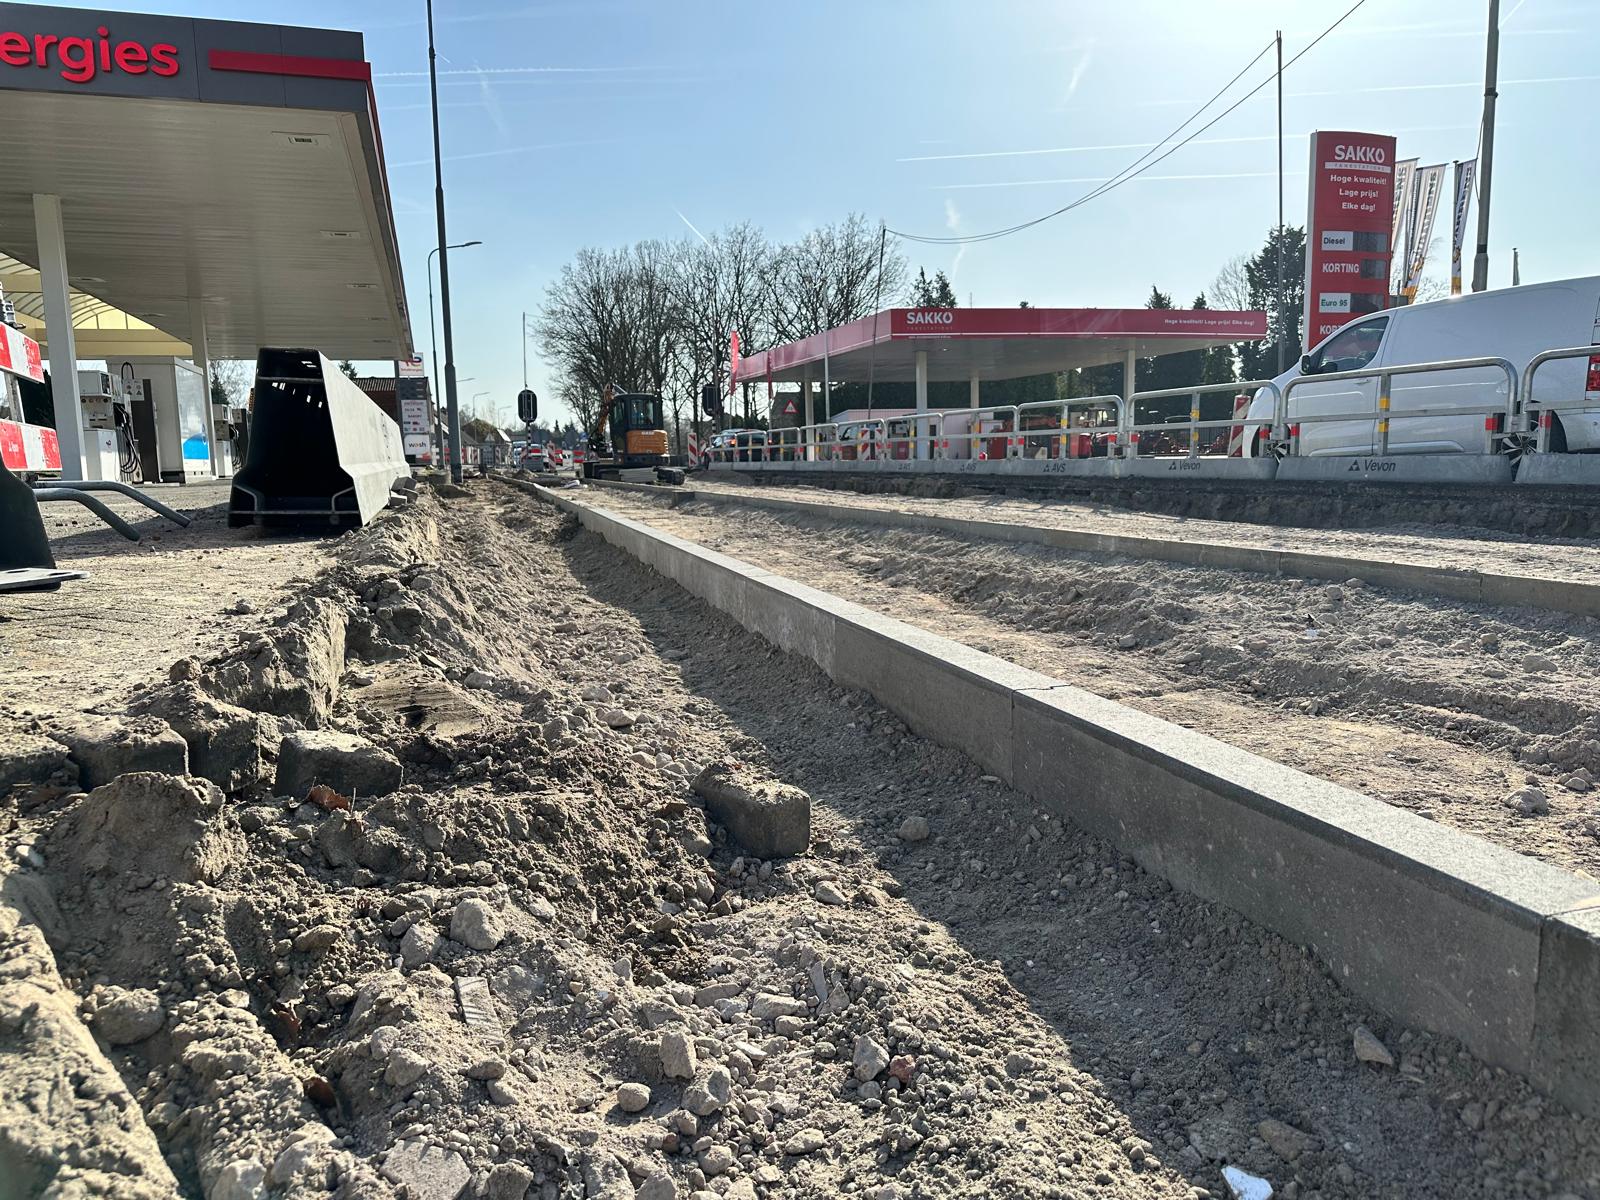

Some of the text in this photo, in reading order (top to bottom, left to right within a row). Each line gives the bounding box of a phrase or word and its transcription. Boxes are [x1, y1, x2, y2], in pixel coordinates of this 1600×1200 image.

[0, 26, 180, 83] ergies
[1334, 144, 1386, 164] SAKKO
[1330, 174, 1387, 185] Hoge kwaliteit!
[1339, 188, 1379, 198] Lage prijs!
[1341, 202, 1376, 212] Elke dag!
[1323, 237, 1346, 245] Diesel
[1322, 262, 1360, 273] KORTING
[1320, 299, 1348, 307] Euro 95
[906, 311, 953, 324] SAKKO
[1320, 325, 1342, 335] KOR
[1051, 463, 1066, 472] AVS
[1179, 461, 1200, 471] Vevon
[1364, 459, 1396, 472] Vevon
